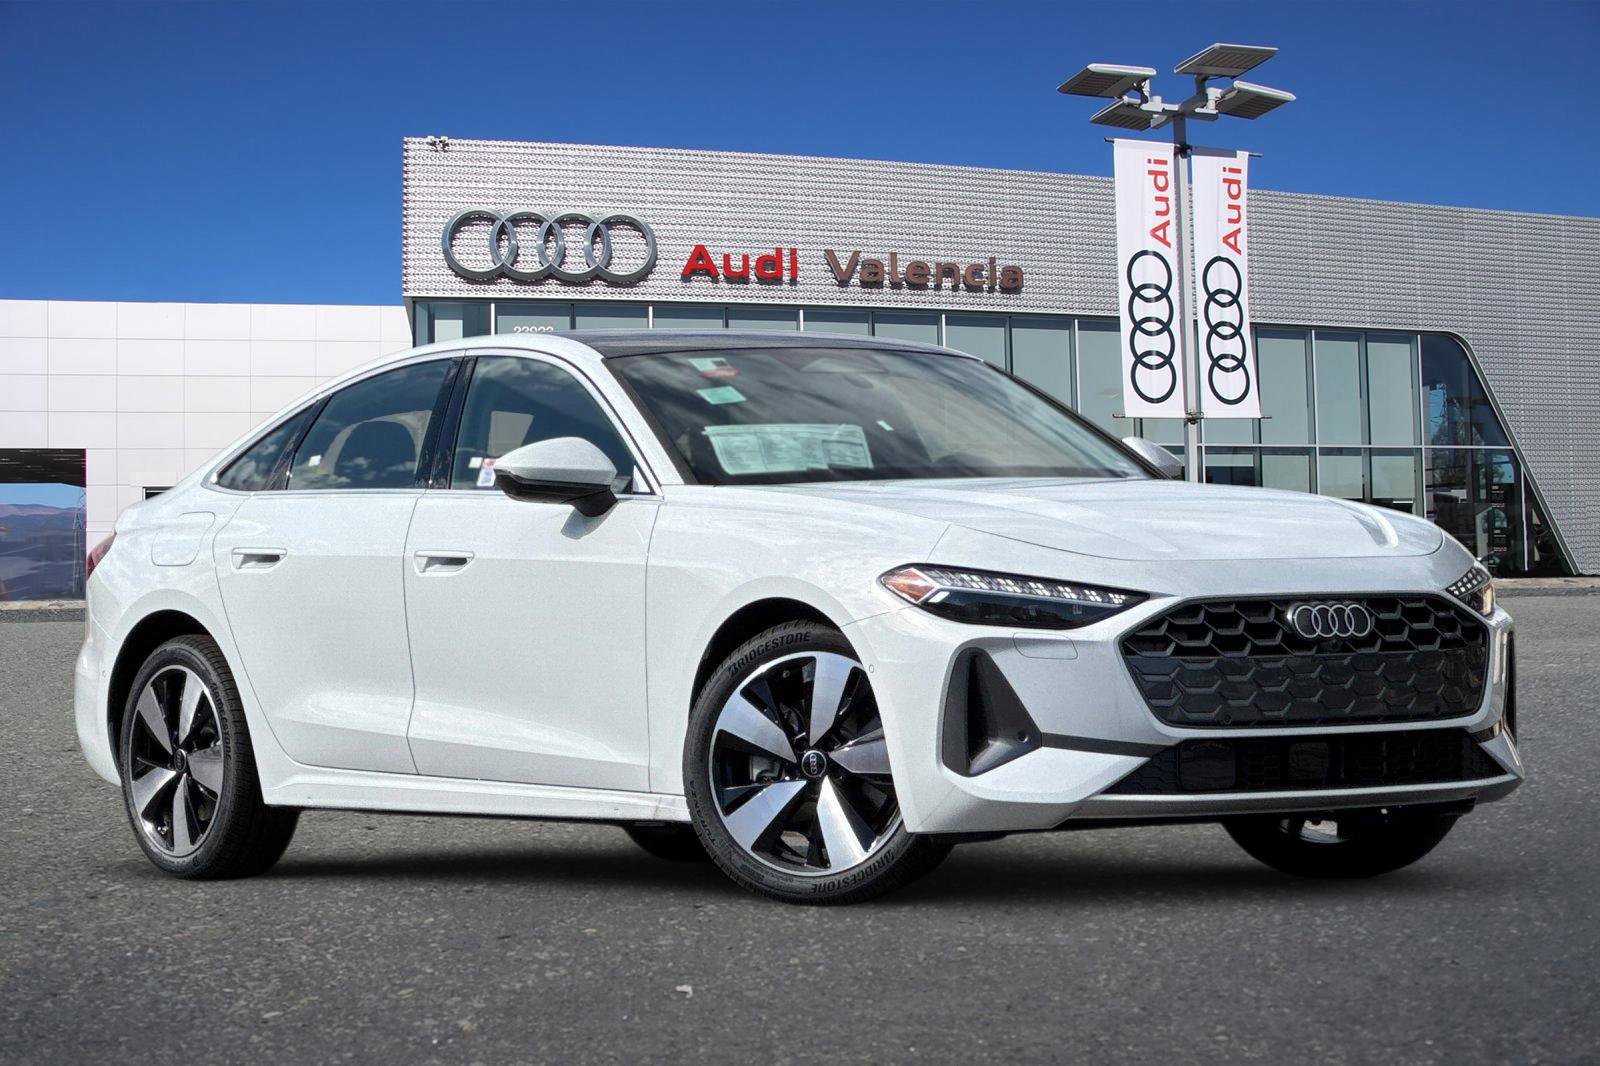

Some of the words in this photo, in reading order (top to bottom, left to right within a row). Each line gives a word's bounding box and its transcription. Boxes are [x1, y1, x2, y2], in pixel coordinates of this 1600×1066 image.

[1147, 158, 1171, 248] Audi
[1222, 167, 1242, 255] Audi
[681, 244, 798, 281] Audi
[824, 249, 1024, 291] Valencia
[728, 631, 812, 674] BRIDGESTONE
[809, 849, 895, 893] BRIDGESTONE
